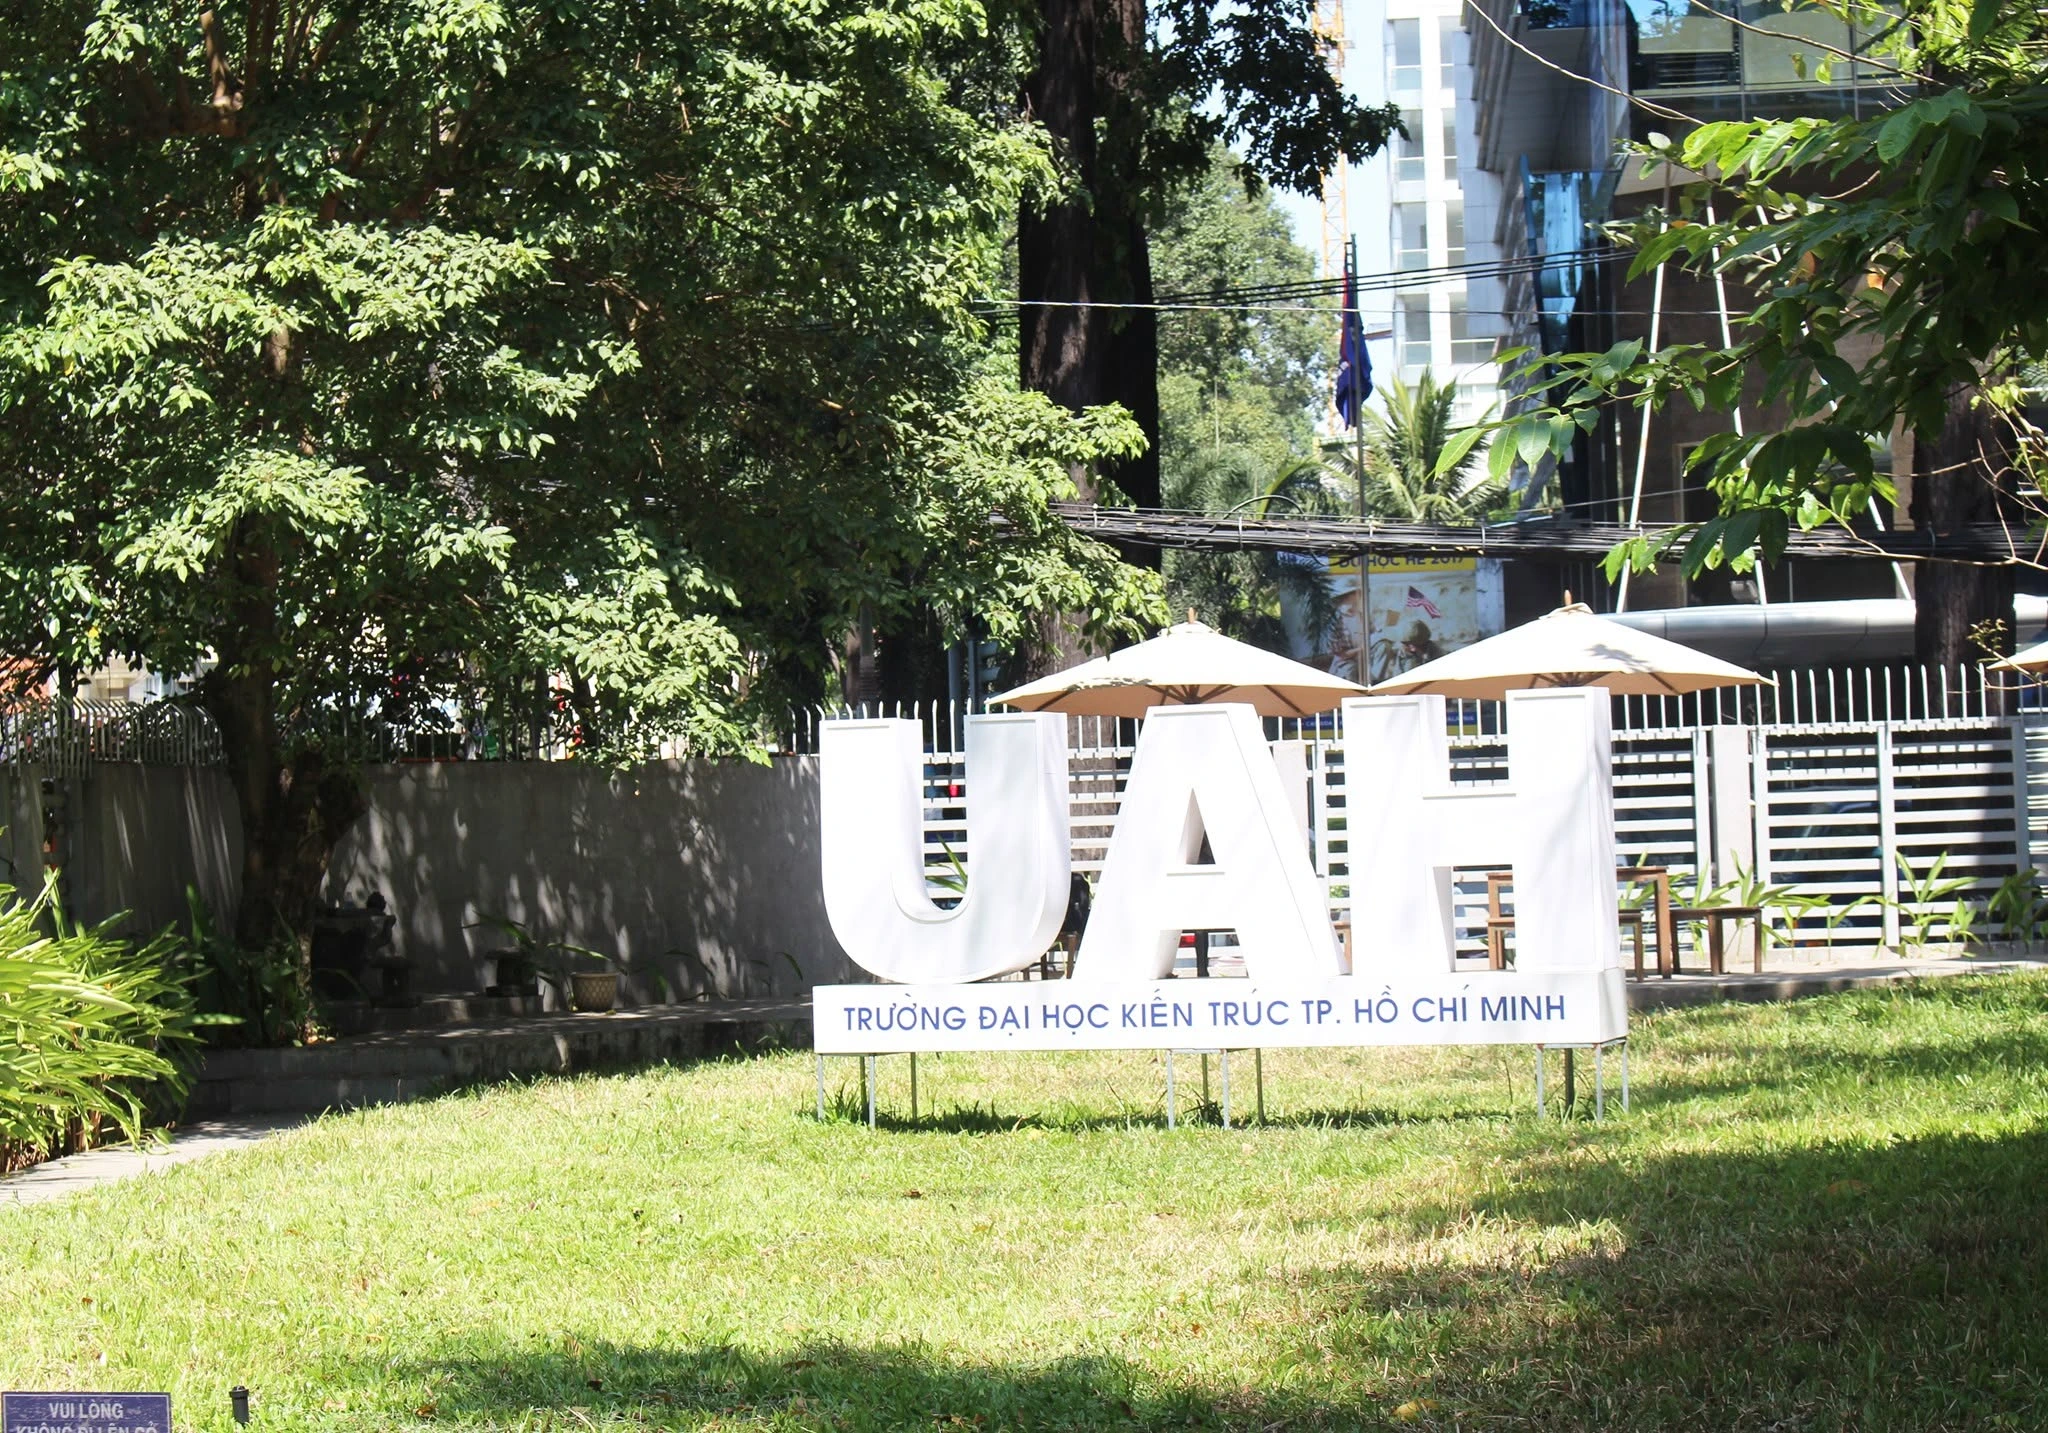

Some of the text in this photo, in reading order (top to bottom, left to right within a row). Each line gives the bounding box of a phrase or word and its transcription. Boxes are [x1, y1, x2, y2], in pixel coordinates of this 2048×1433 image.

[819, 686, 1617, 984] UAH
[844, 984, 1565, 1036] TRƯỜNG ĐẠI HỌC KIẾN TRÚC TP. HỒ CHÍ MINH
[49, 1399, 124, 1419] VUI LÒNG
